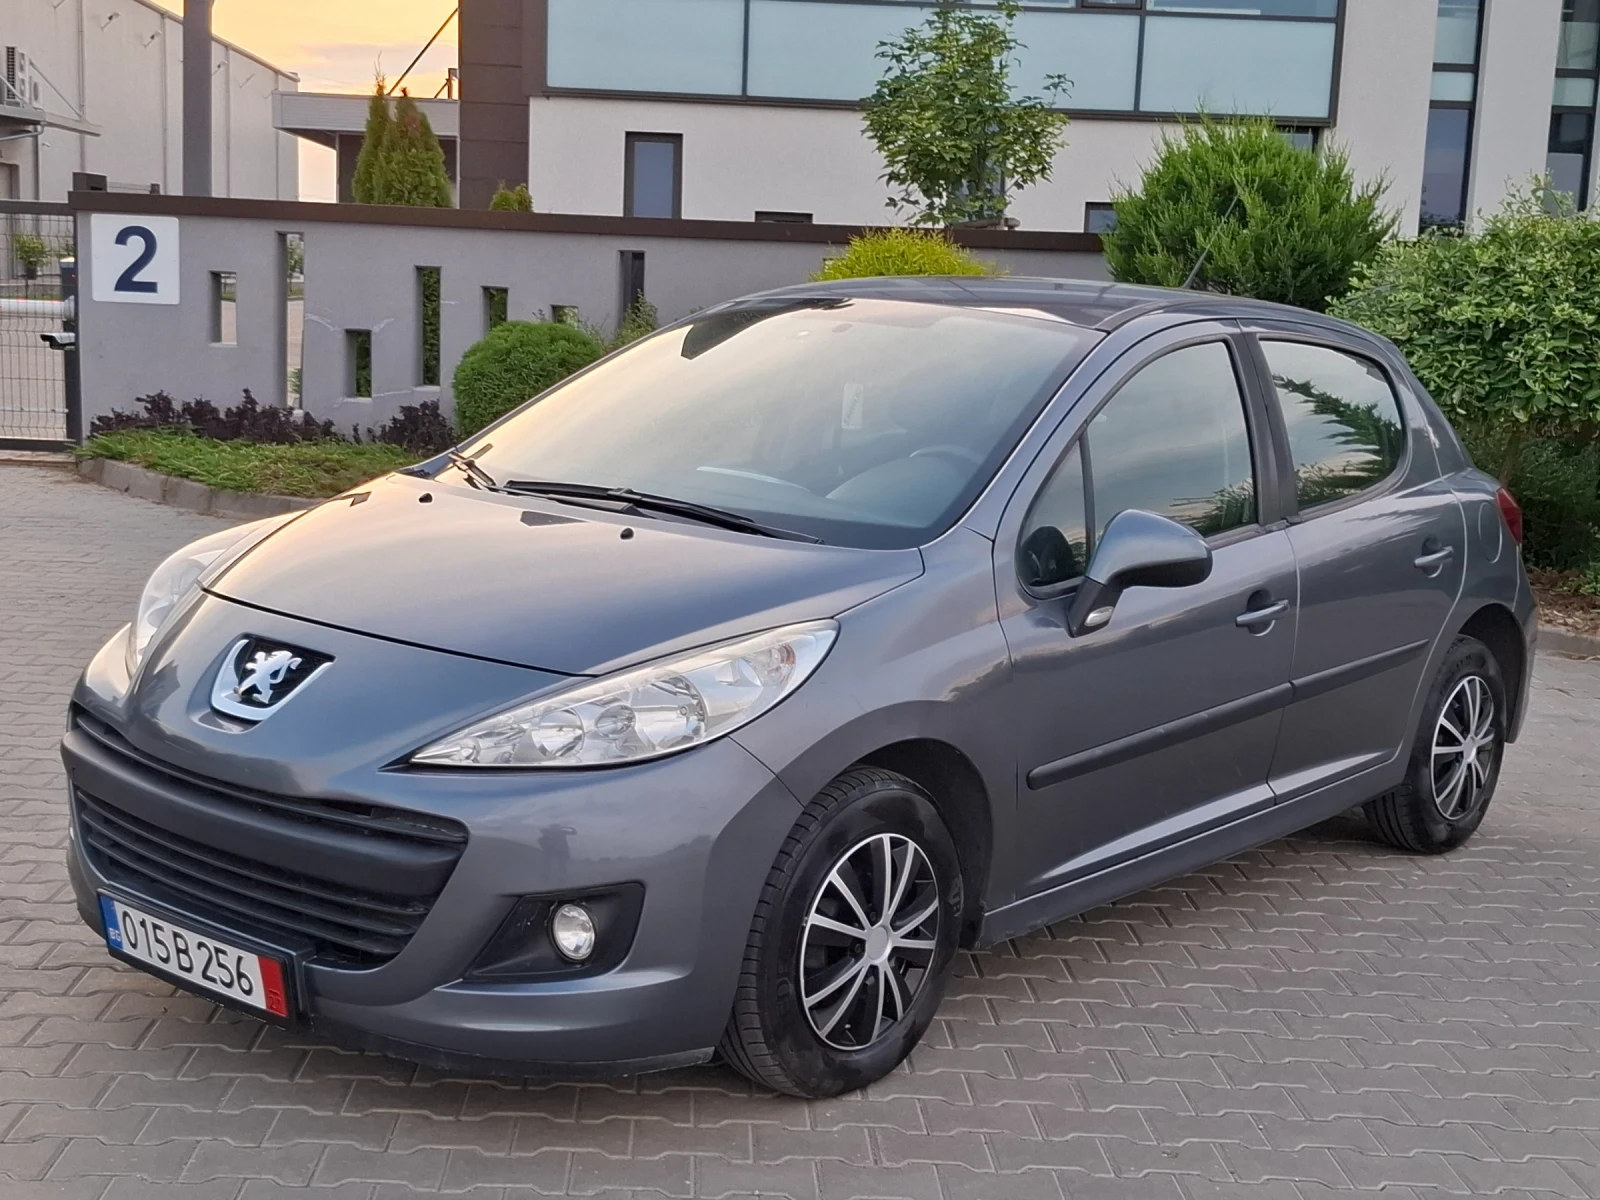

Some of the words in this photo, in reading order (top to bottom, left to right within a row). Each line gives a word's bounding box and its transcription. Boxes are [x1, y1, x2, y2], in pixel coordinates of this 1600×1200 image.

[114, 225, 158, 293] 2
[108, 927, 121, 942] BG
[122, 910, 254, 996] 015B256
